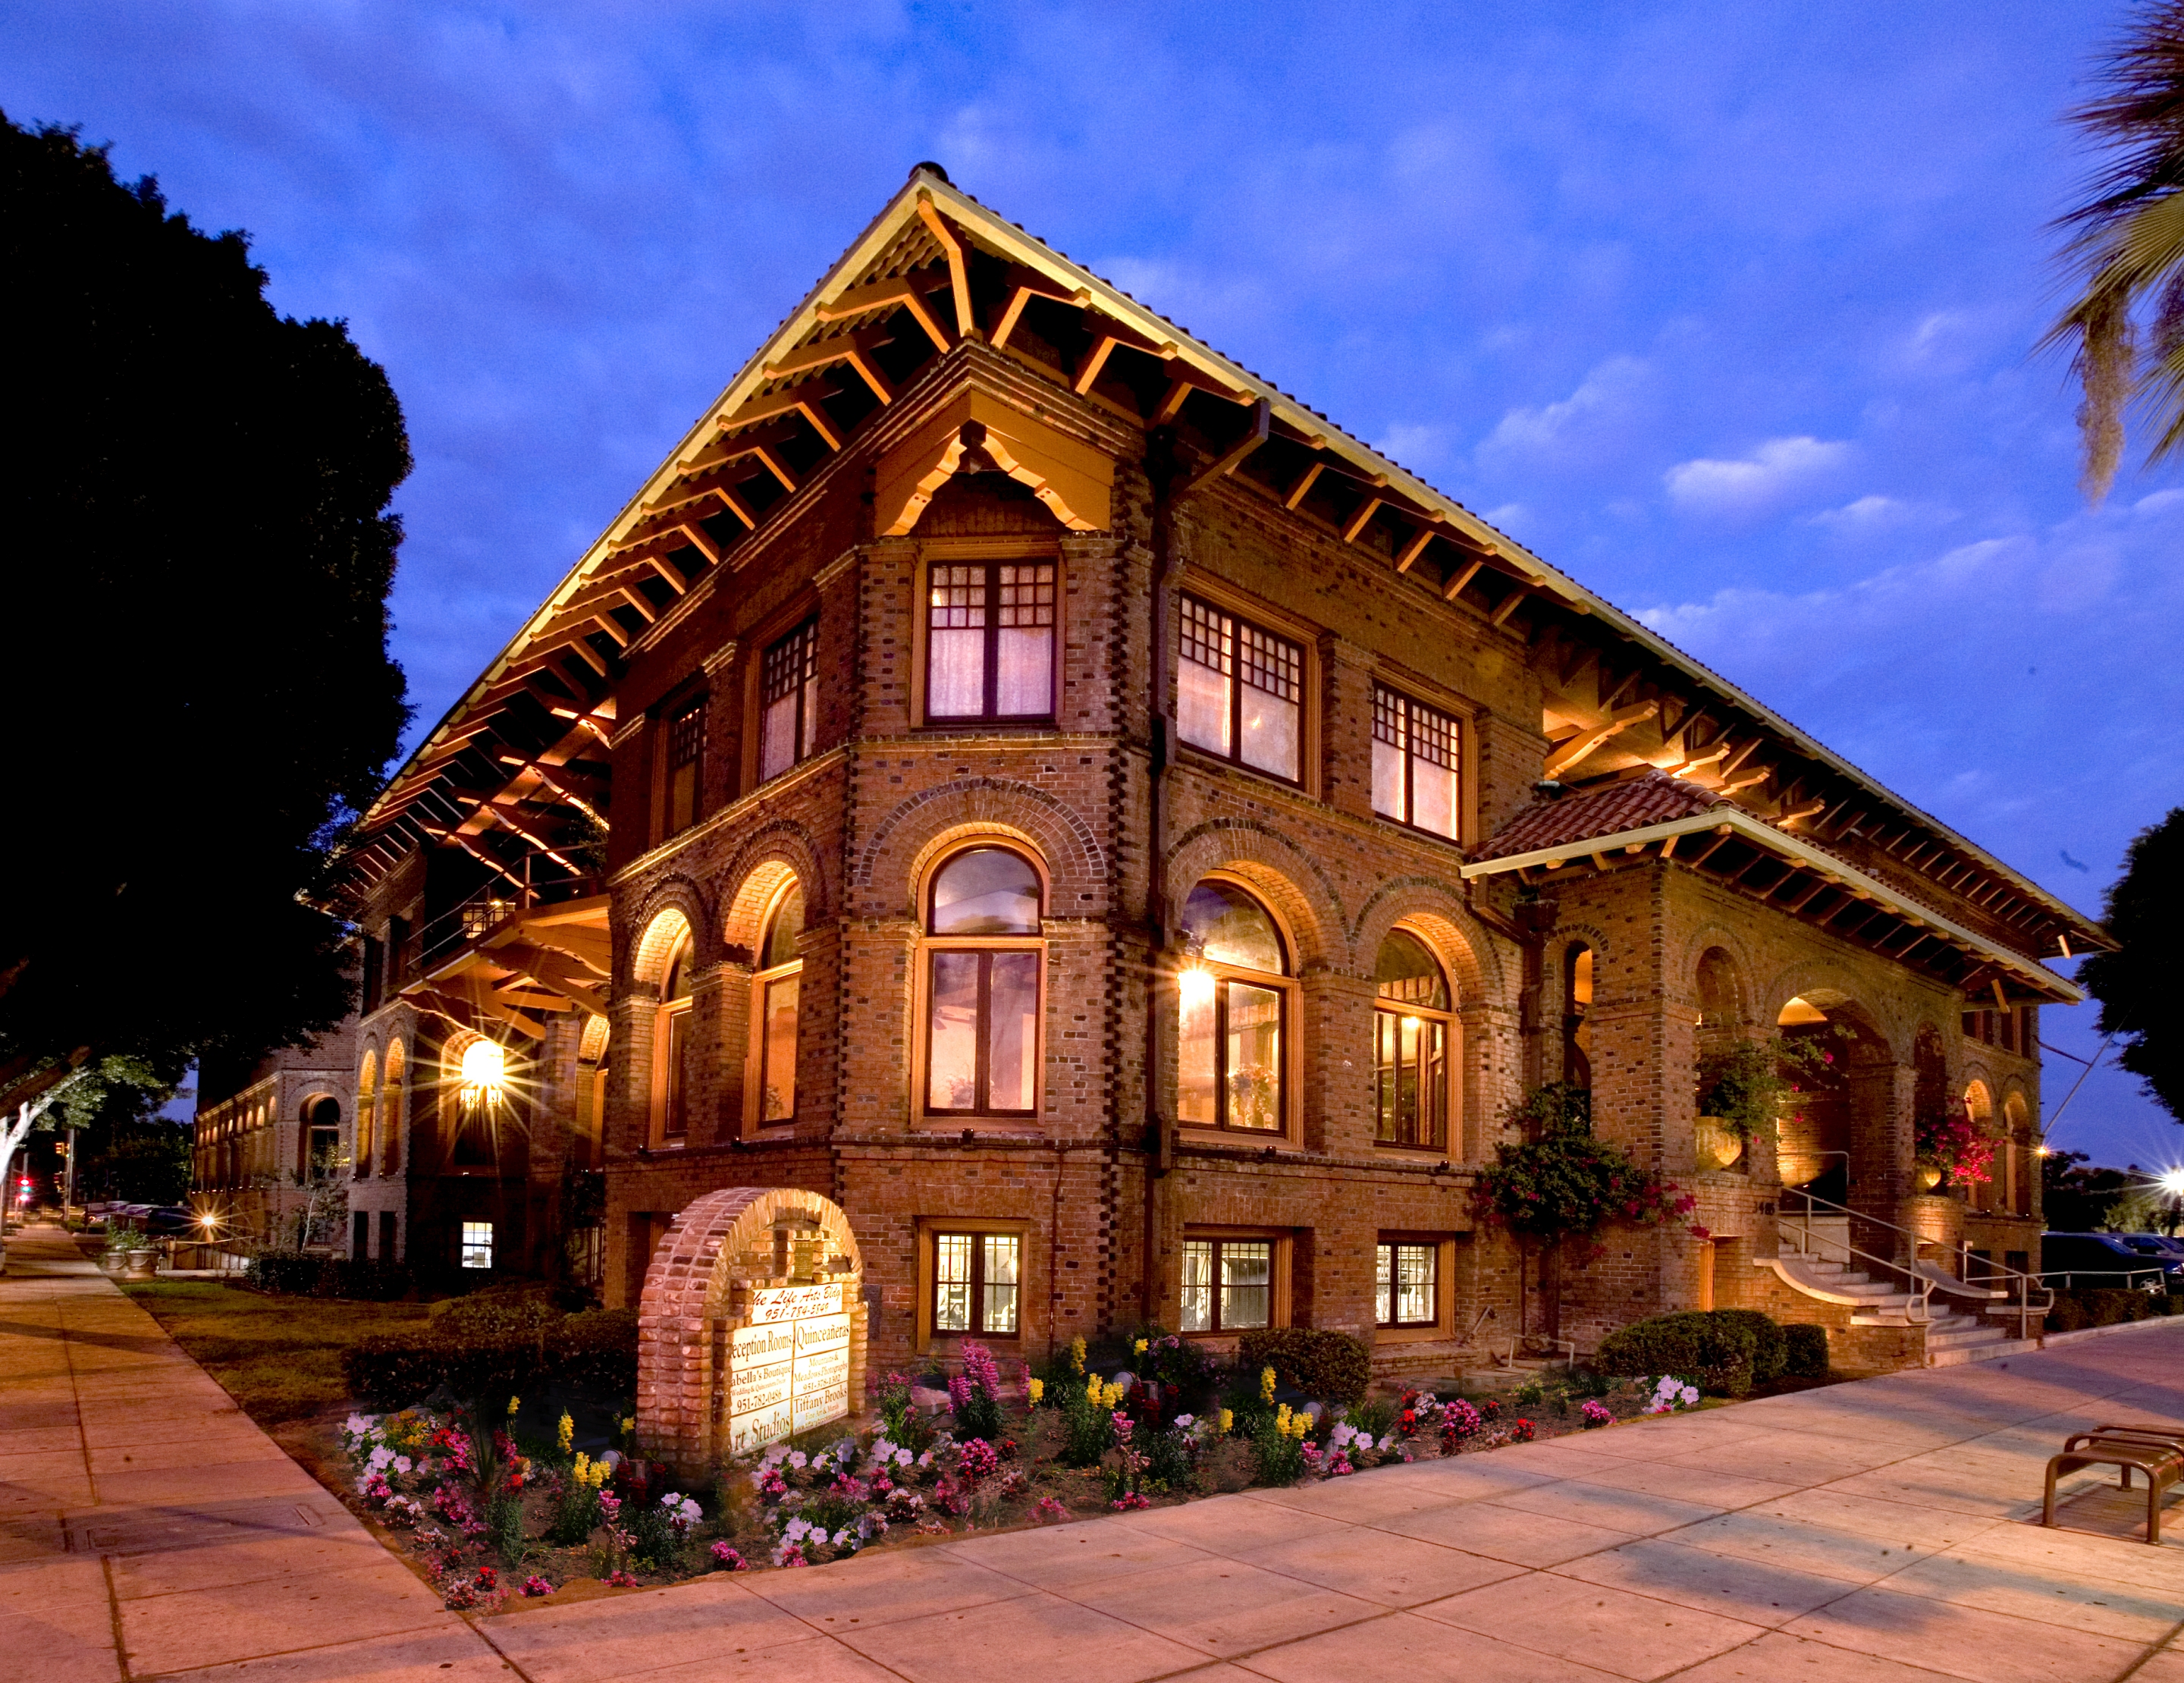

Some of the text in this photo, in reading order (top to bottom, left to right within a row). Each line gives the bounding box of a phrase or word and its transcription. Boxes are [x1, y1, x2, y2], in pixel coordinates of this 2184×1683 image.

[752, 1291, 767, 1306] he
[770, 1289, 798, 1309] Life
[799, 1288, 821, 1303] Arts
[732, 1330, 792, 1362] eception Rooms
[796, 1324, 849, 1351] Quinceañeras
[834, 1352, 839, 1361] &
[731, 1365, 792, 1386] abella's Boutique
[736, 1388, 782, 1413] 951-782-0486
[750, 1385, 755, 1393] &
[793, 1384, 848, 1414] Tiffany Brooks
[823, 1406, 828, 1415] &
[751, 1410, 790, 1445] Studios
